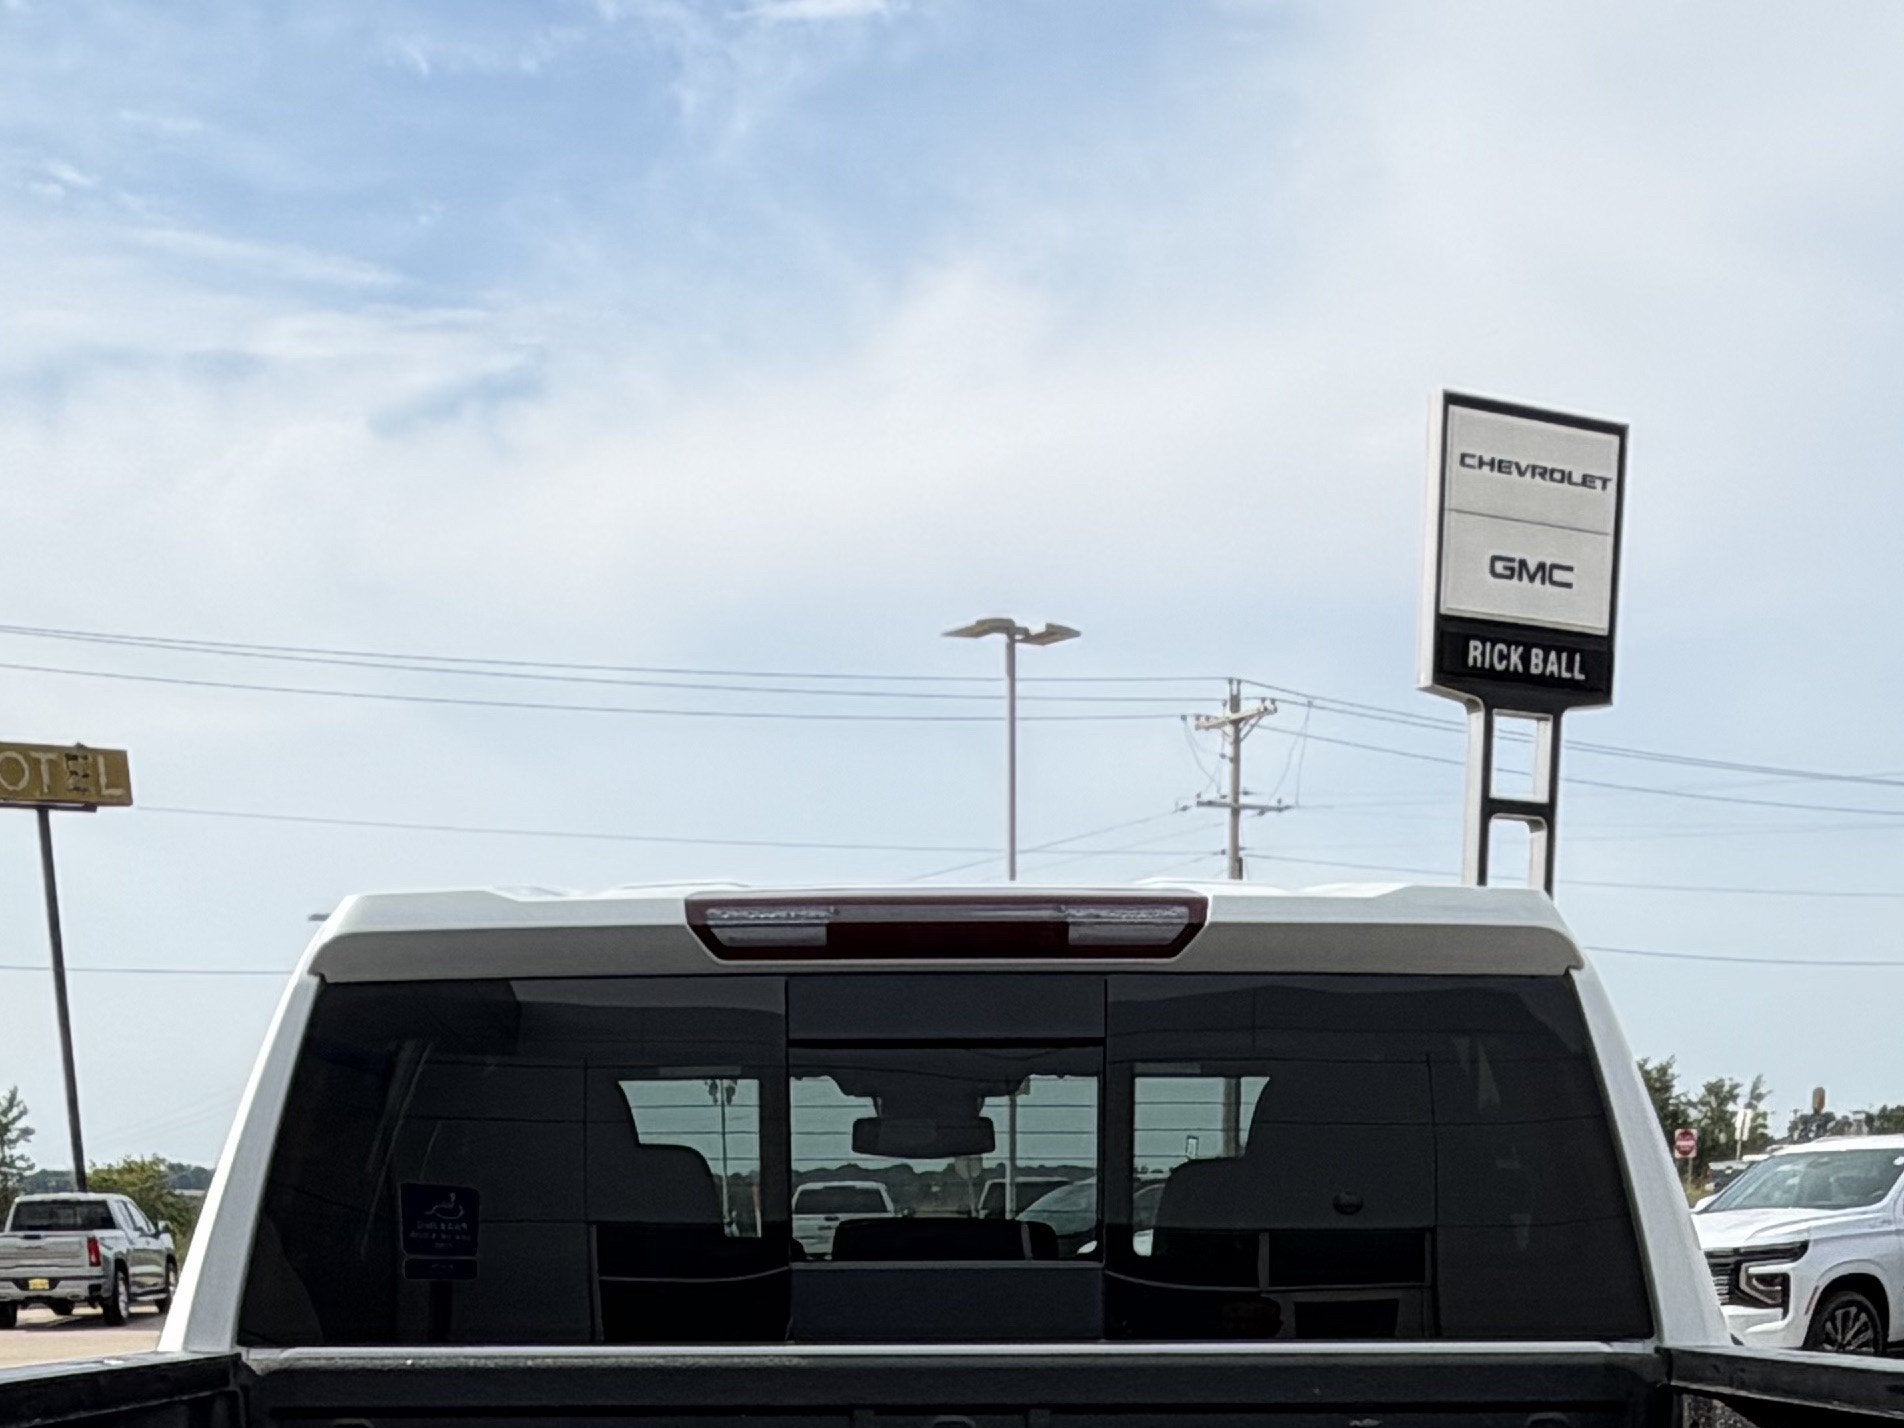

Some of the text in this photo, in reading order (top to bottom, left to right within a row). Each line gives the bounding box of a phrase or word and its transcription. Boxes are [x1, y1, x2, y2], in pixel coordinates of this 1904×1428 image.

[1459, 452, 1612, 491] CHEVROLET
[1489, 554, 1574, 589] GMC
[1468, 639, 1585, 681] RICK BALL
